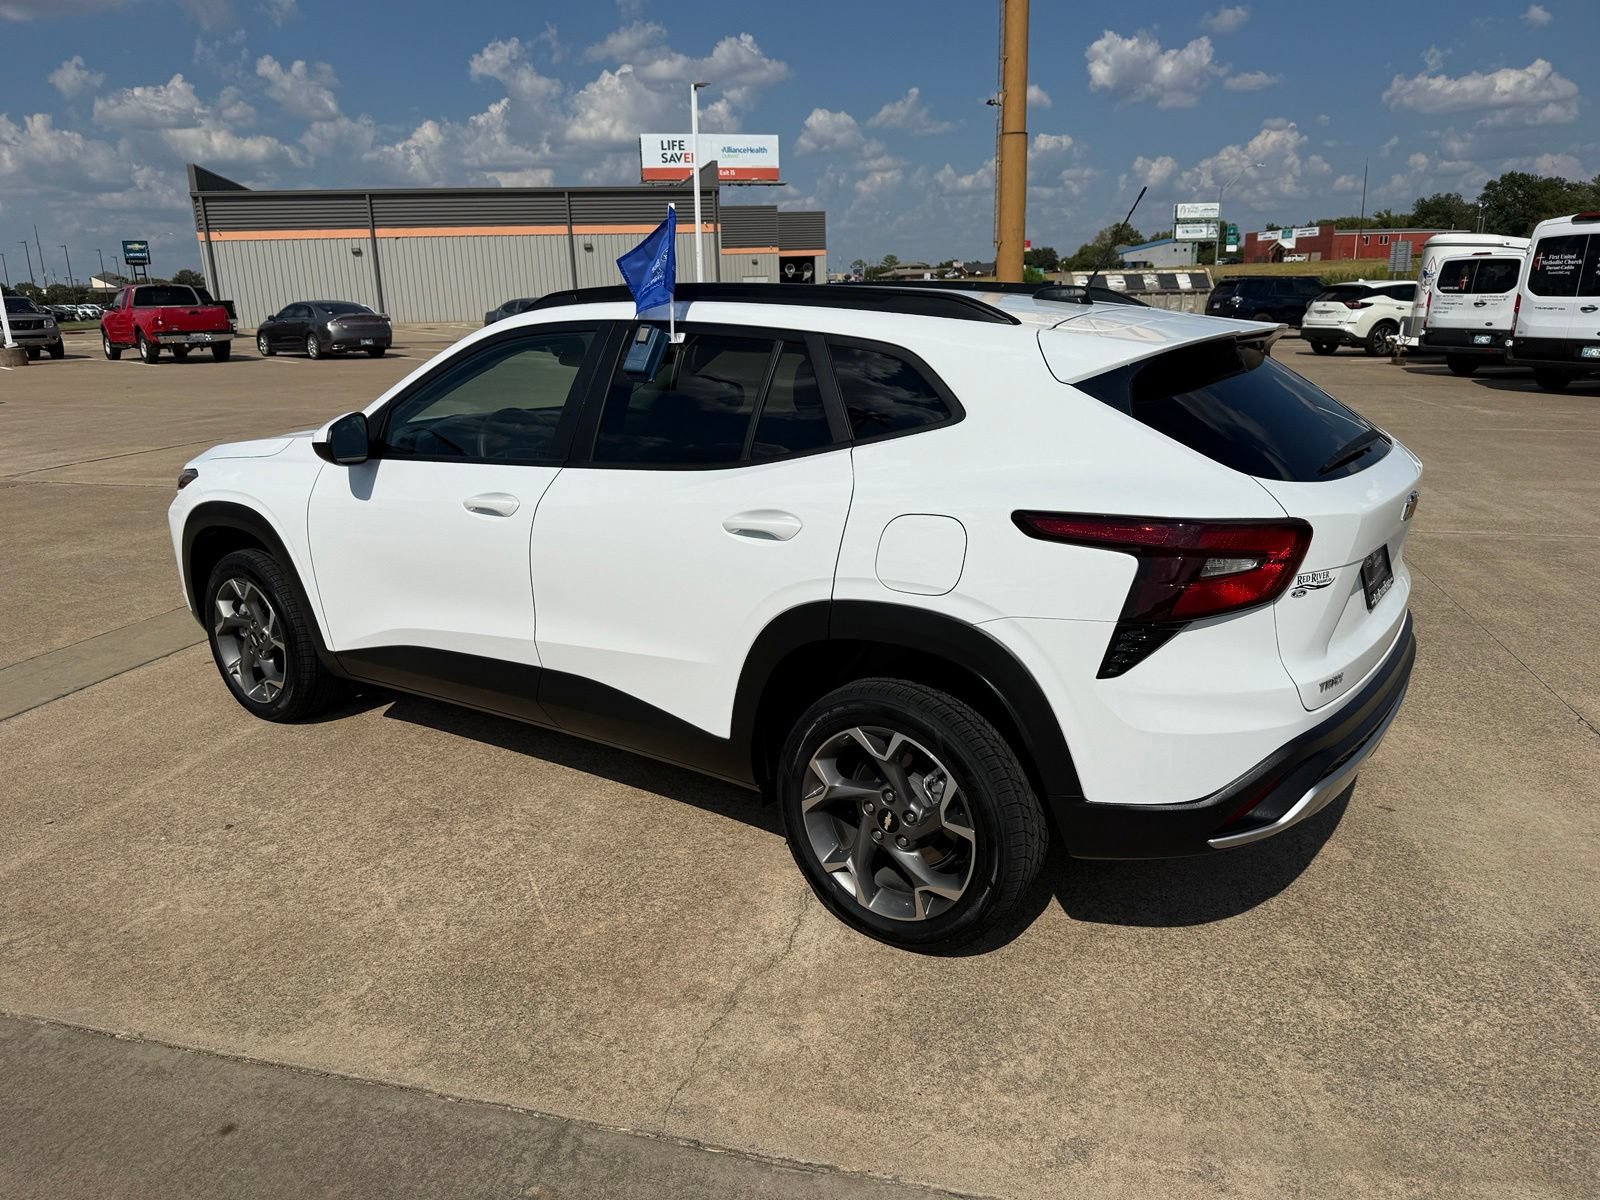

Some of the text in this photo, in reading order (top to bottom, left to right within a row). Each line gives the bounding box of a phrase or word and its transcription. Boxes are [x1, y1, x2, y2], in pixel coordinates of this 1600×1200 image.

[660, 140, 685, 151] LIFE
[721, 146, 768, 154] AllianceHealth
[661, 153, 694, 164] SAVE
[1297, 571, 1330, 585] RED RIVER
